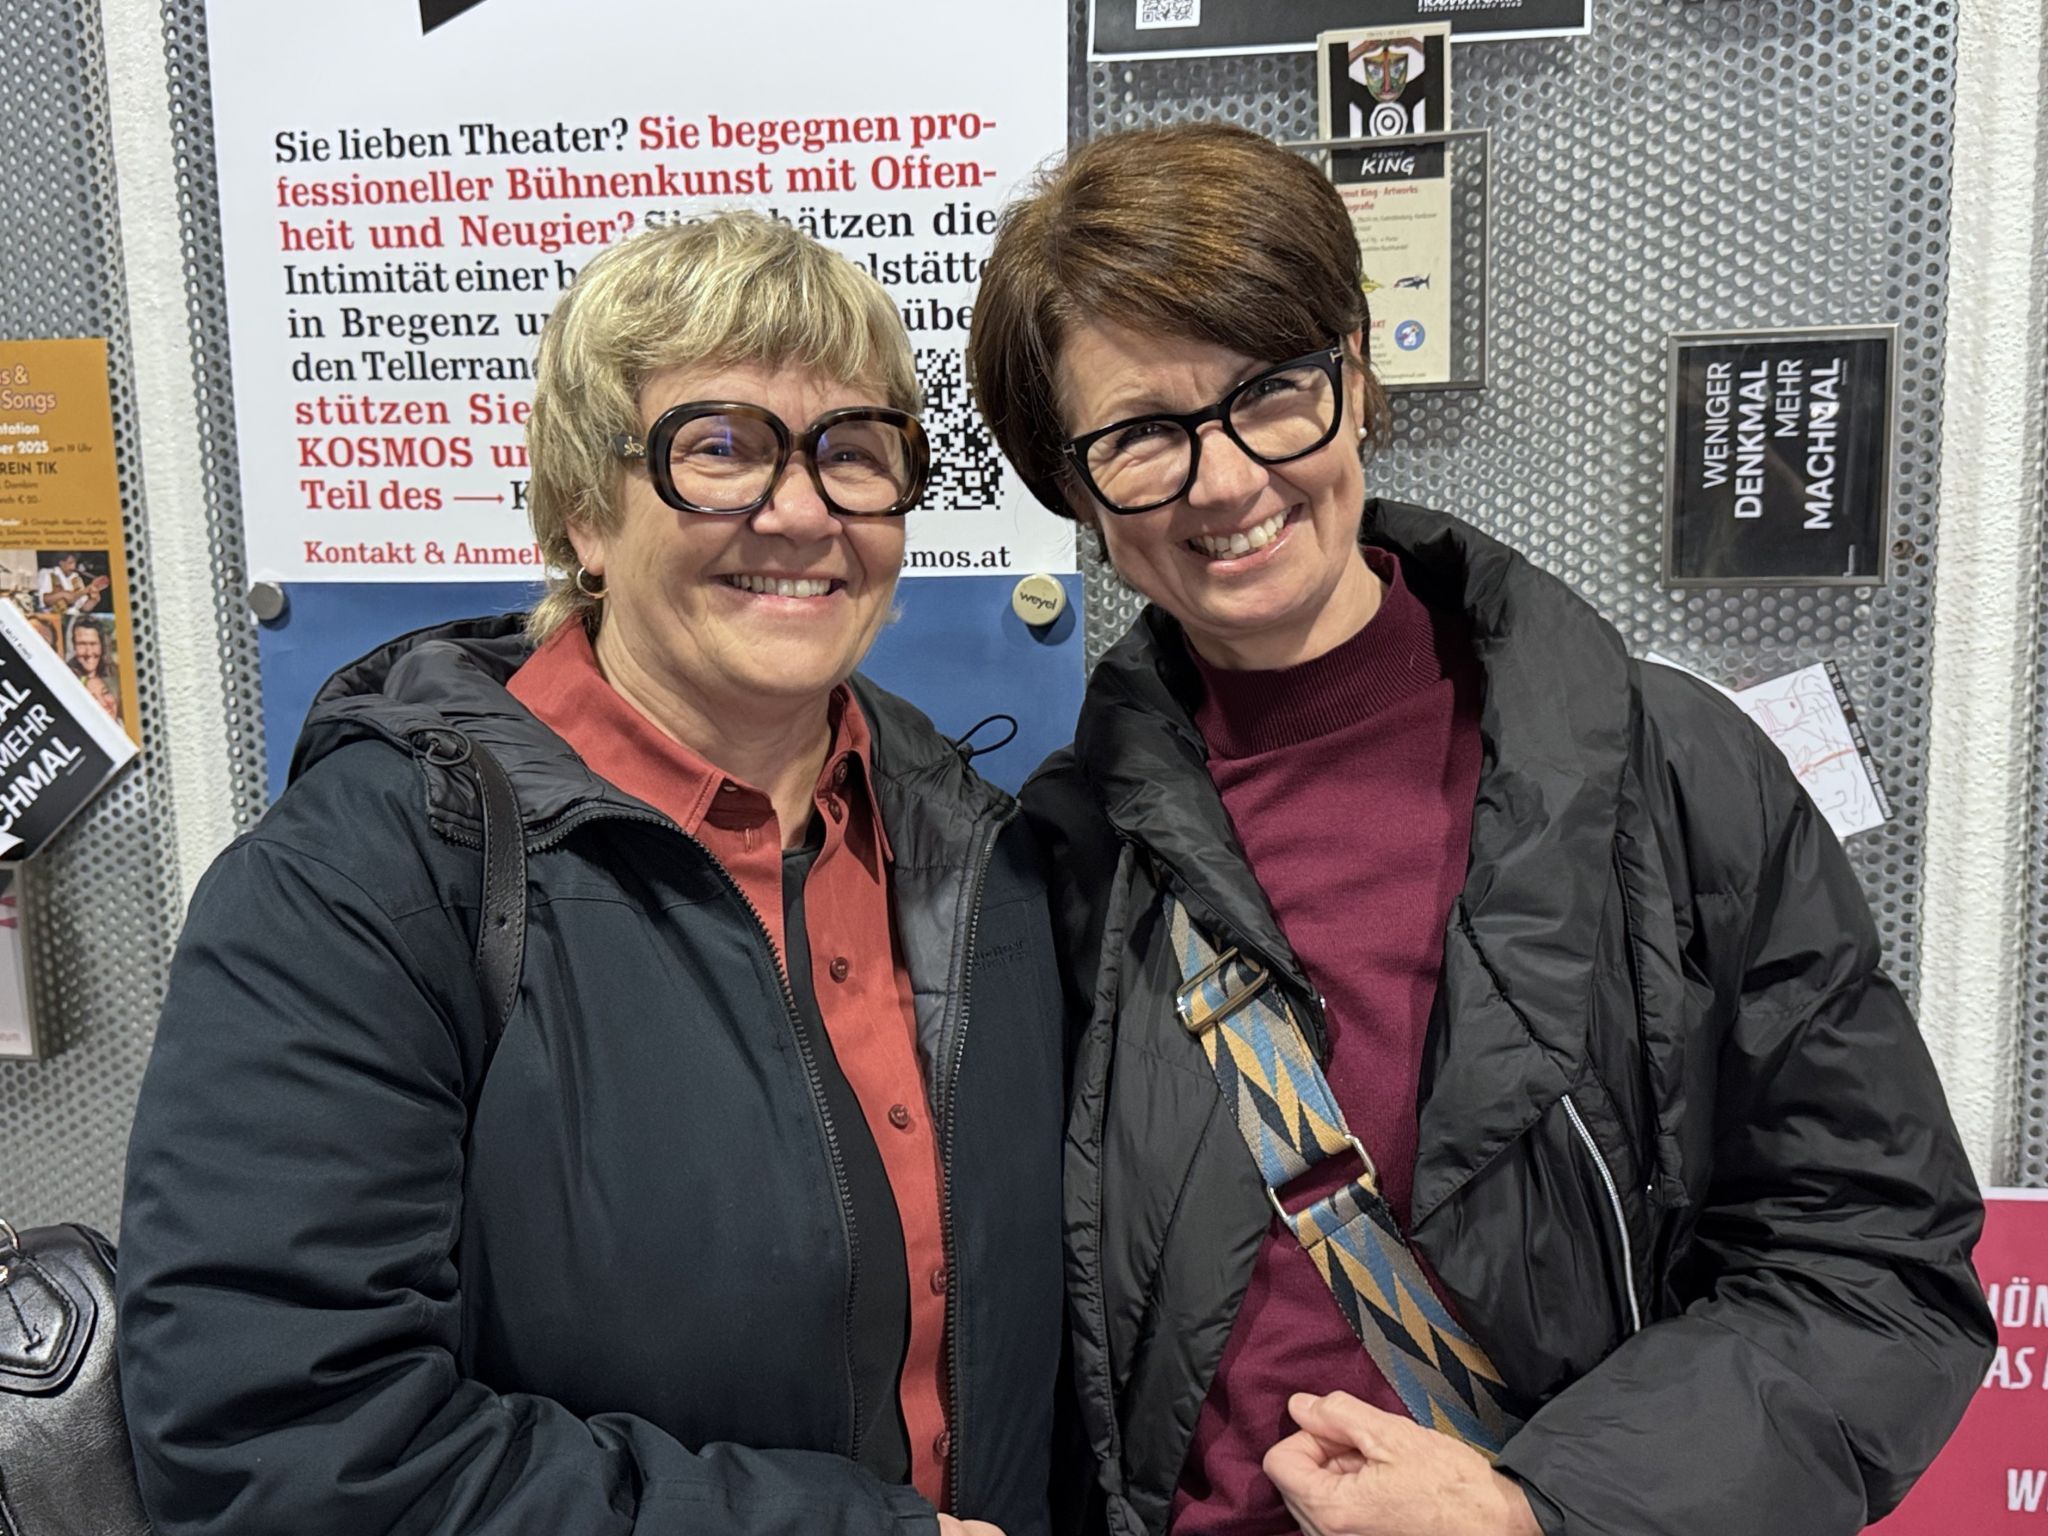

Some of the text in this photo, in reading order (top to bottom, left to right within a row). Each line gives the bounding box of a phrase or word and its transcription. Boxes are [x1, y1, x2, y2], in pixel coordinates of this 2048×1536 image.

[276, 114, 995, 163] Sie lieben Theater? Sie begegnen pro-
[278, 155, 996, 207] fessioneller Bühnenkunst mit Offen-
[1361, 155, 1415, 176] KING
[280, 219, 354, 251] heit
[369, 217, 443, 249] und
[459, 211, 634, 254] Neugier?
[932, 201, 998, 237] die
[284, 262, 449, 294] Intimität
[456, 260, 548, 292] einer
[288, 309, 325, 338] in
[340, 308, 499, 345] Bregenz
[14, 365, 28, 384] &
[292, 352, 356, 381] den
[2, 389, 56, 414] Songs
[296, 393, 531, 425] stützen Sie
[1774, 359, 1803, 437] MEHR
[1703, 362, 1732, 488] WENIGER
[1735, 360, 1768, 518] DENKMAL
[17, 441, 49, 454] 2025
[298, 437, 473, 467] KOSMOS
[36, 461, 57, 474] TIK
[301, 480, 370, 509] Teil
[380, 480, 442, 510] des
[305, 542, 415, 563] Kontakt
[425, 542, 445, 563] &
[1020, 592, 1057, 610] weyel
[2007, 1468, 2048, 1513] W
